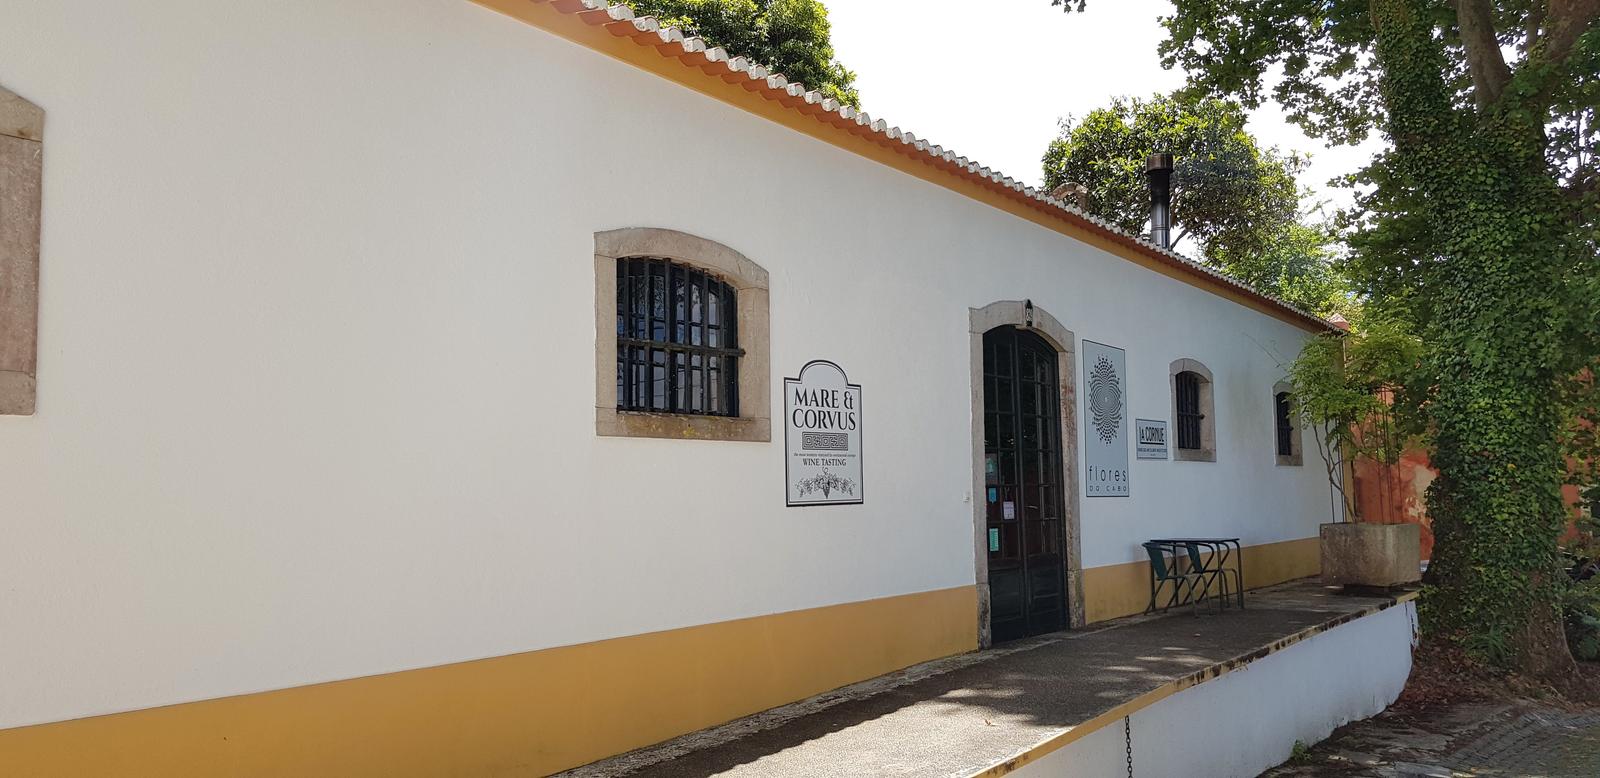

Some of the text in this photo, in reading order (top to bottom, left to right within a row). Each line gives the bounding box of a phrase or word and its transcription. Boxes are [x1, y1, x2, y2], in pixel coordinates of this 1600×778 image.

[794, 387, 854, 410] MARE &
[792, 408, 856, 431] CORVUS
[803, 458, 847, 467] WINE TASTING
[1089, 465, 1127, 482] flores
